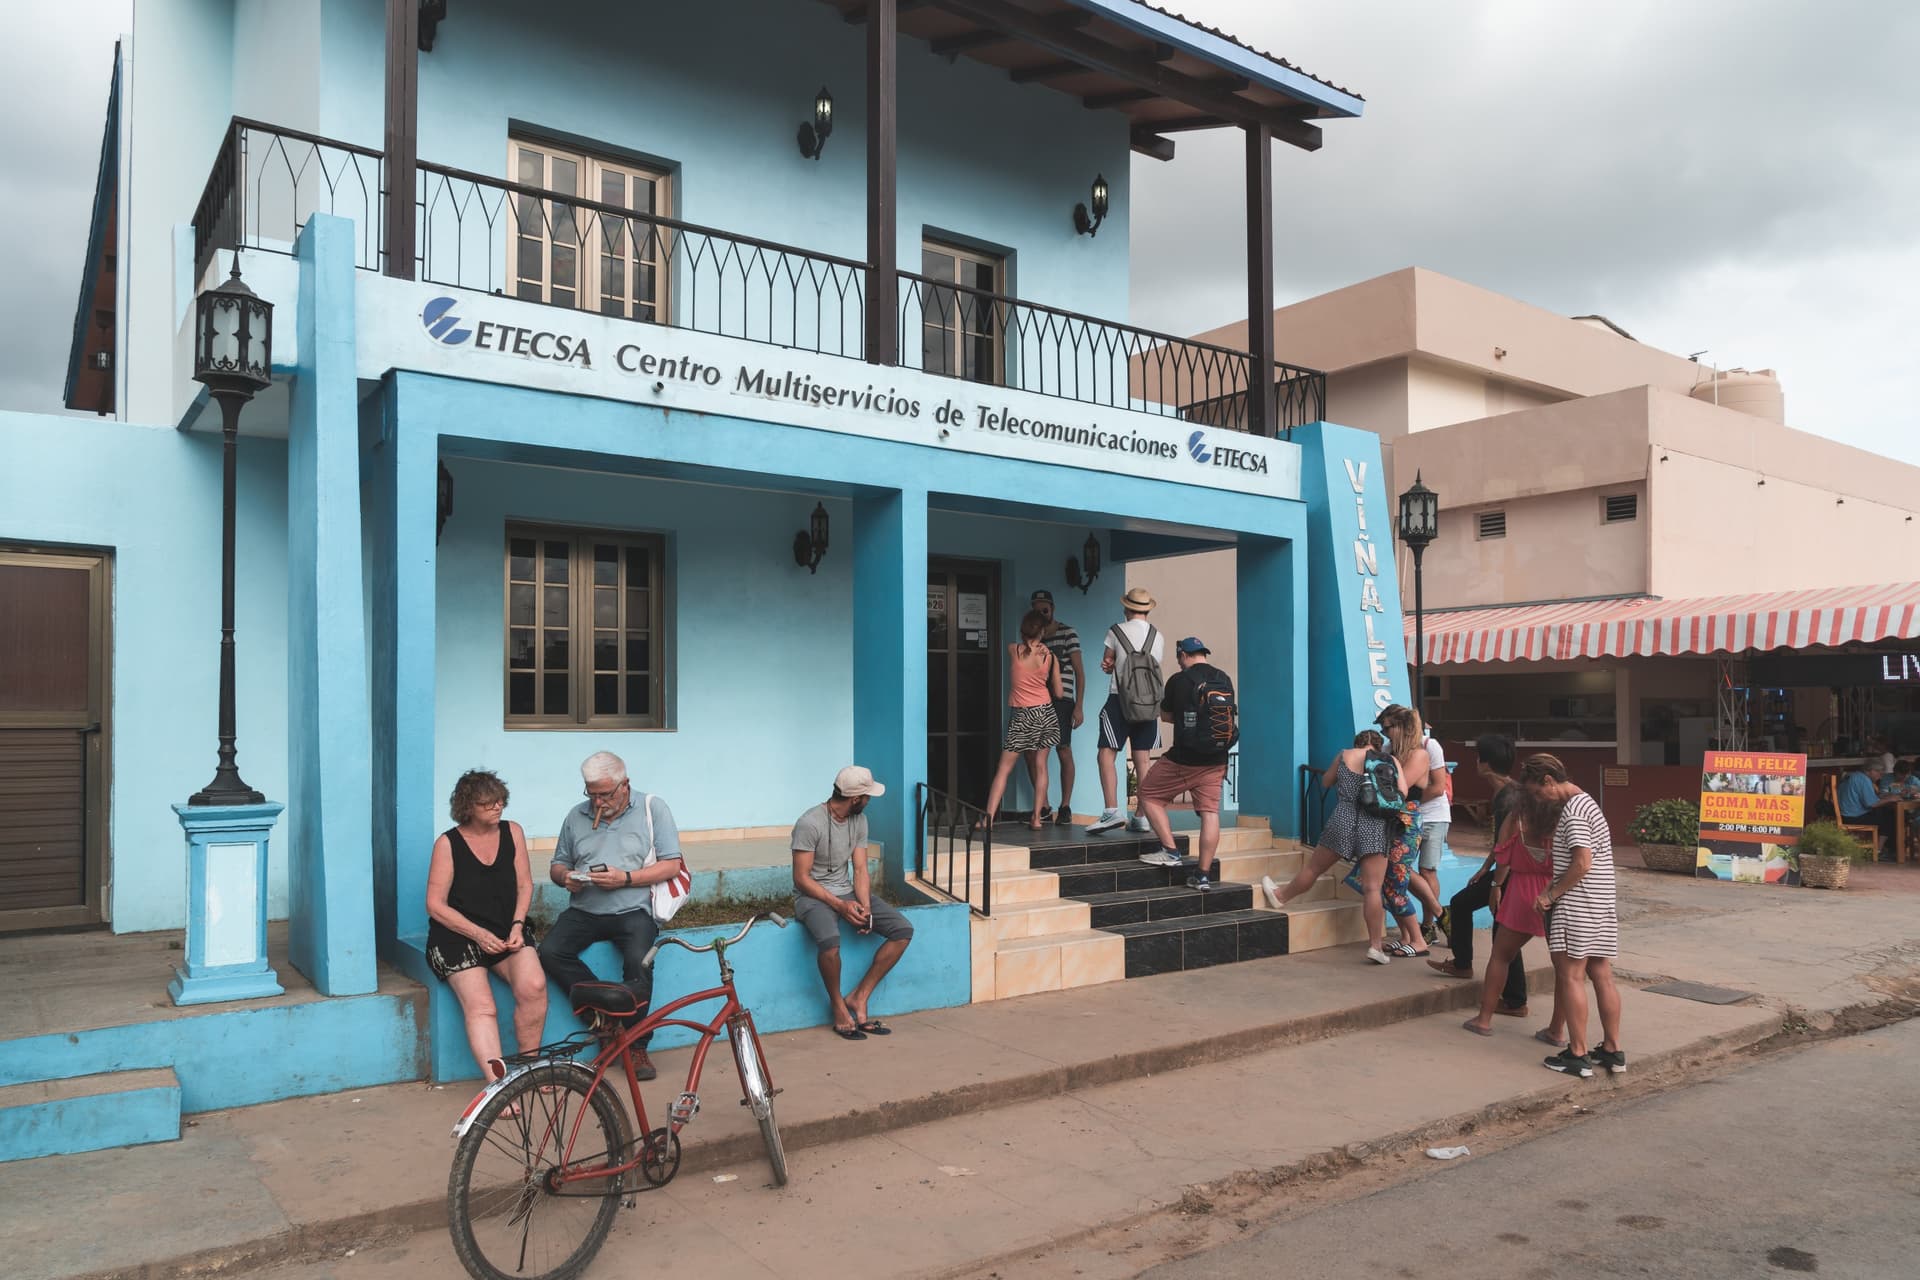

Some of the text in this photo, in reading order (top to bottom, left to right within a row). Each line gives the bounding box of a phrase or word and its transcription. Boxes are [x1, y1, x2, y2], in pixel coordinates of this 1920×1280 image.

[474, 321, 1268, 475] ETECSA Centro Multiservicios de Telecomunicaciones ETECSA
[1713, 756, 1797, 771] HORA FELIZ
[1705, 796, 1749, 809] COMA
[1704, 809, 1743, 820] PAGUE
[1719, 823, 1735, 832] 2:00
[1735, 824, 1747, 832] PM
[1768, 826, 1781, 835] PM
